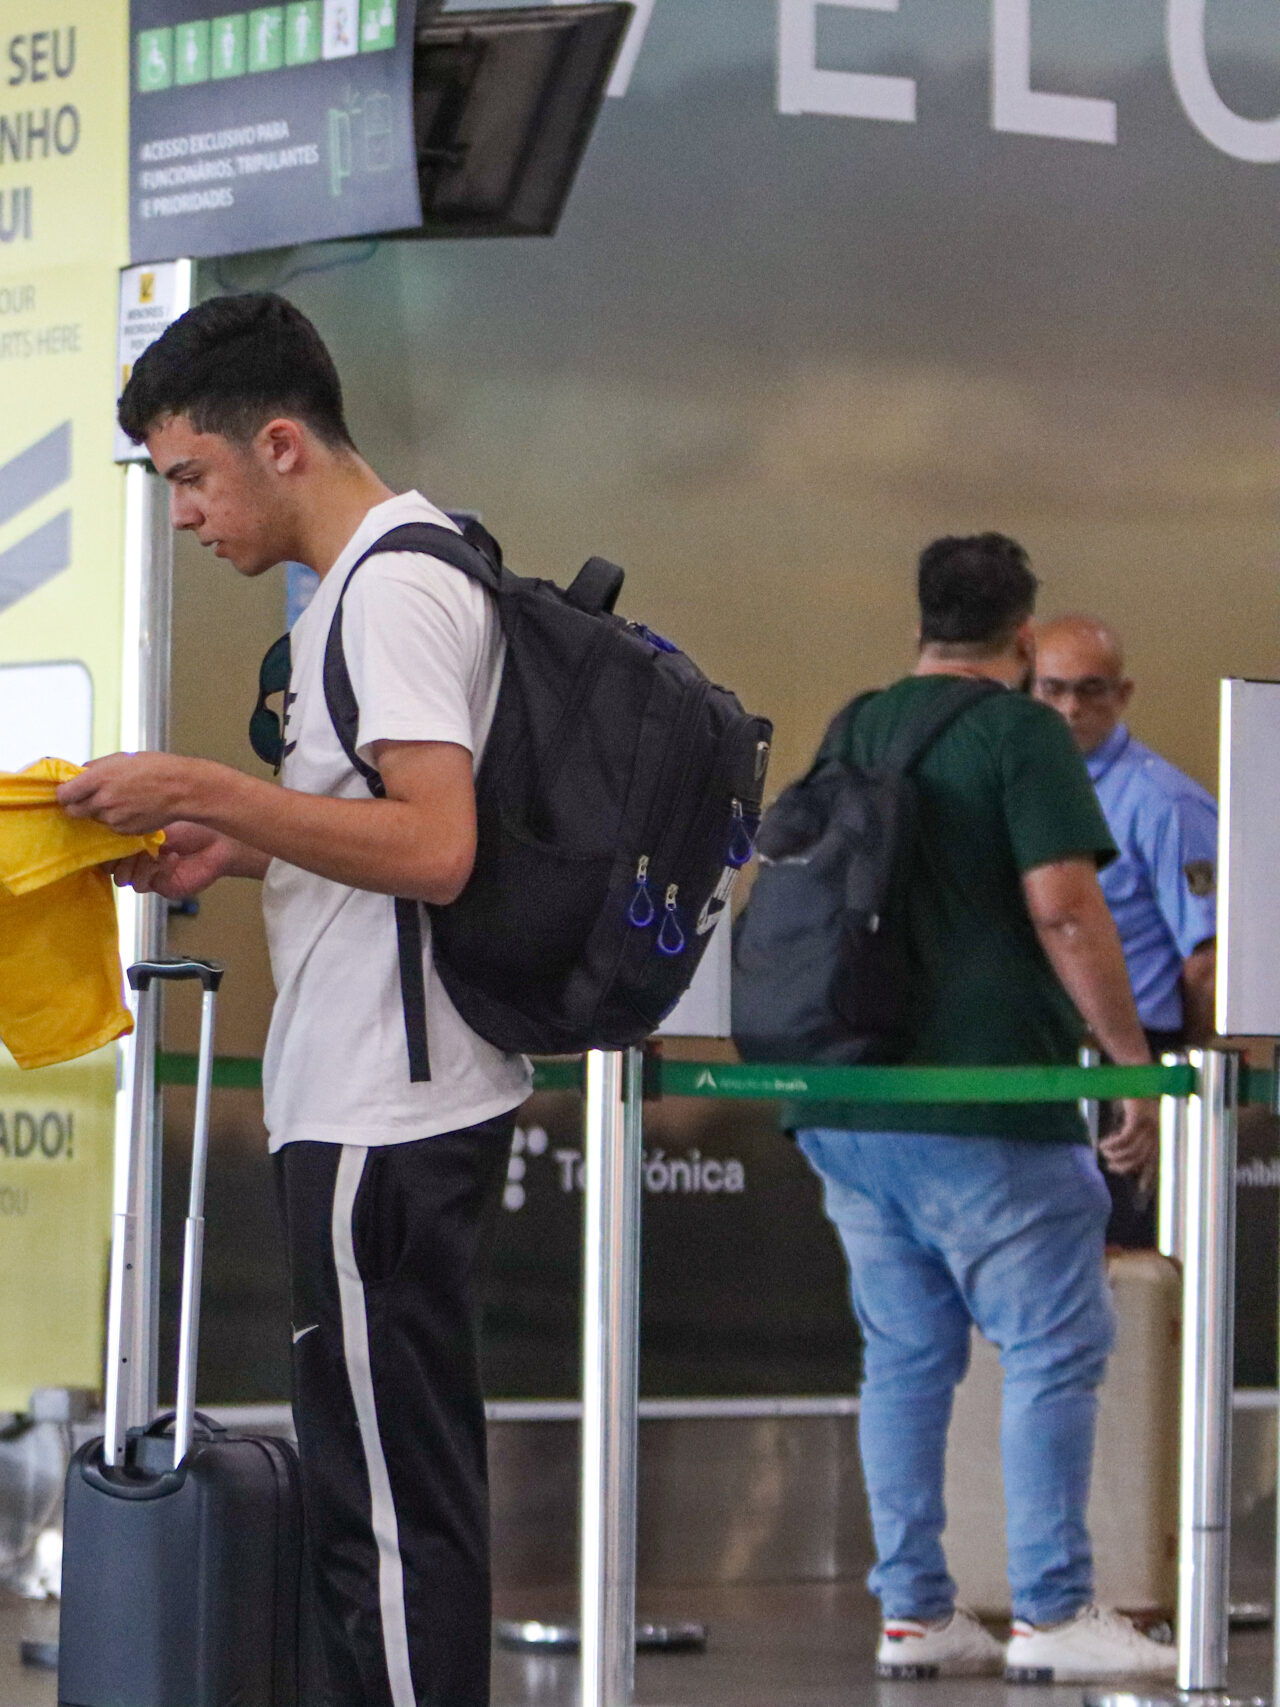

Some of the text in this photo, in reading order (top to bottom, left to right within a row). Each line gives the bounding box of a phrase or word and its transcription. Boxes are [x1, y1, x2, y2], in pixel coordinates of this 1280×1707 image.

[8, 25, 77, 87] SEU
[189, 125, 257, 154] EXCLUSIVO
[36, 322, 82, 356] HERE
